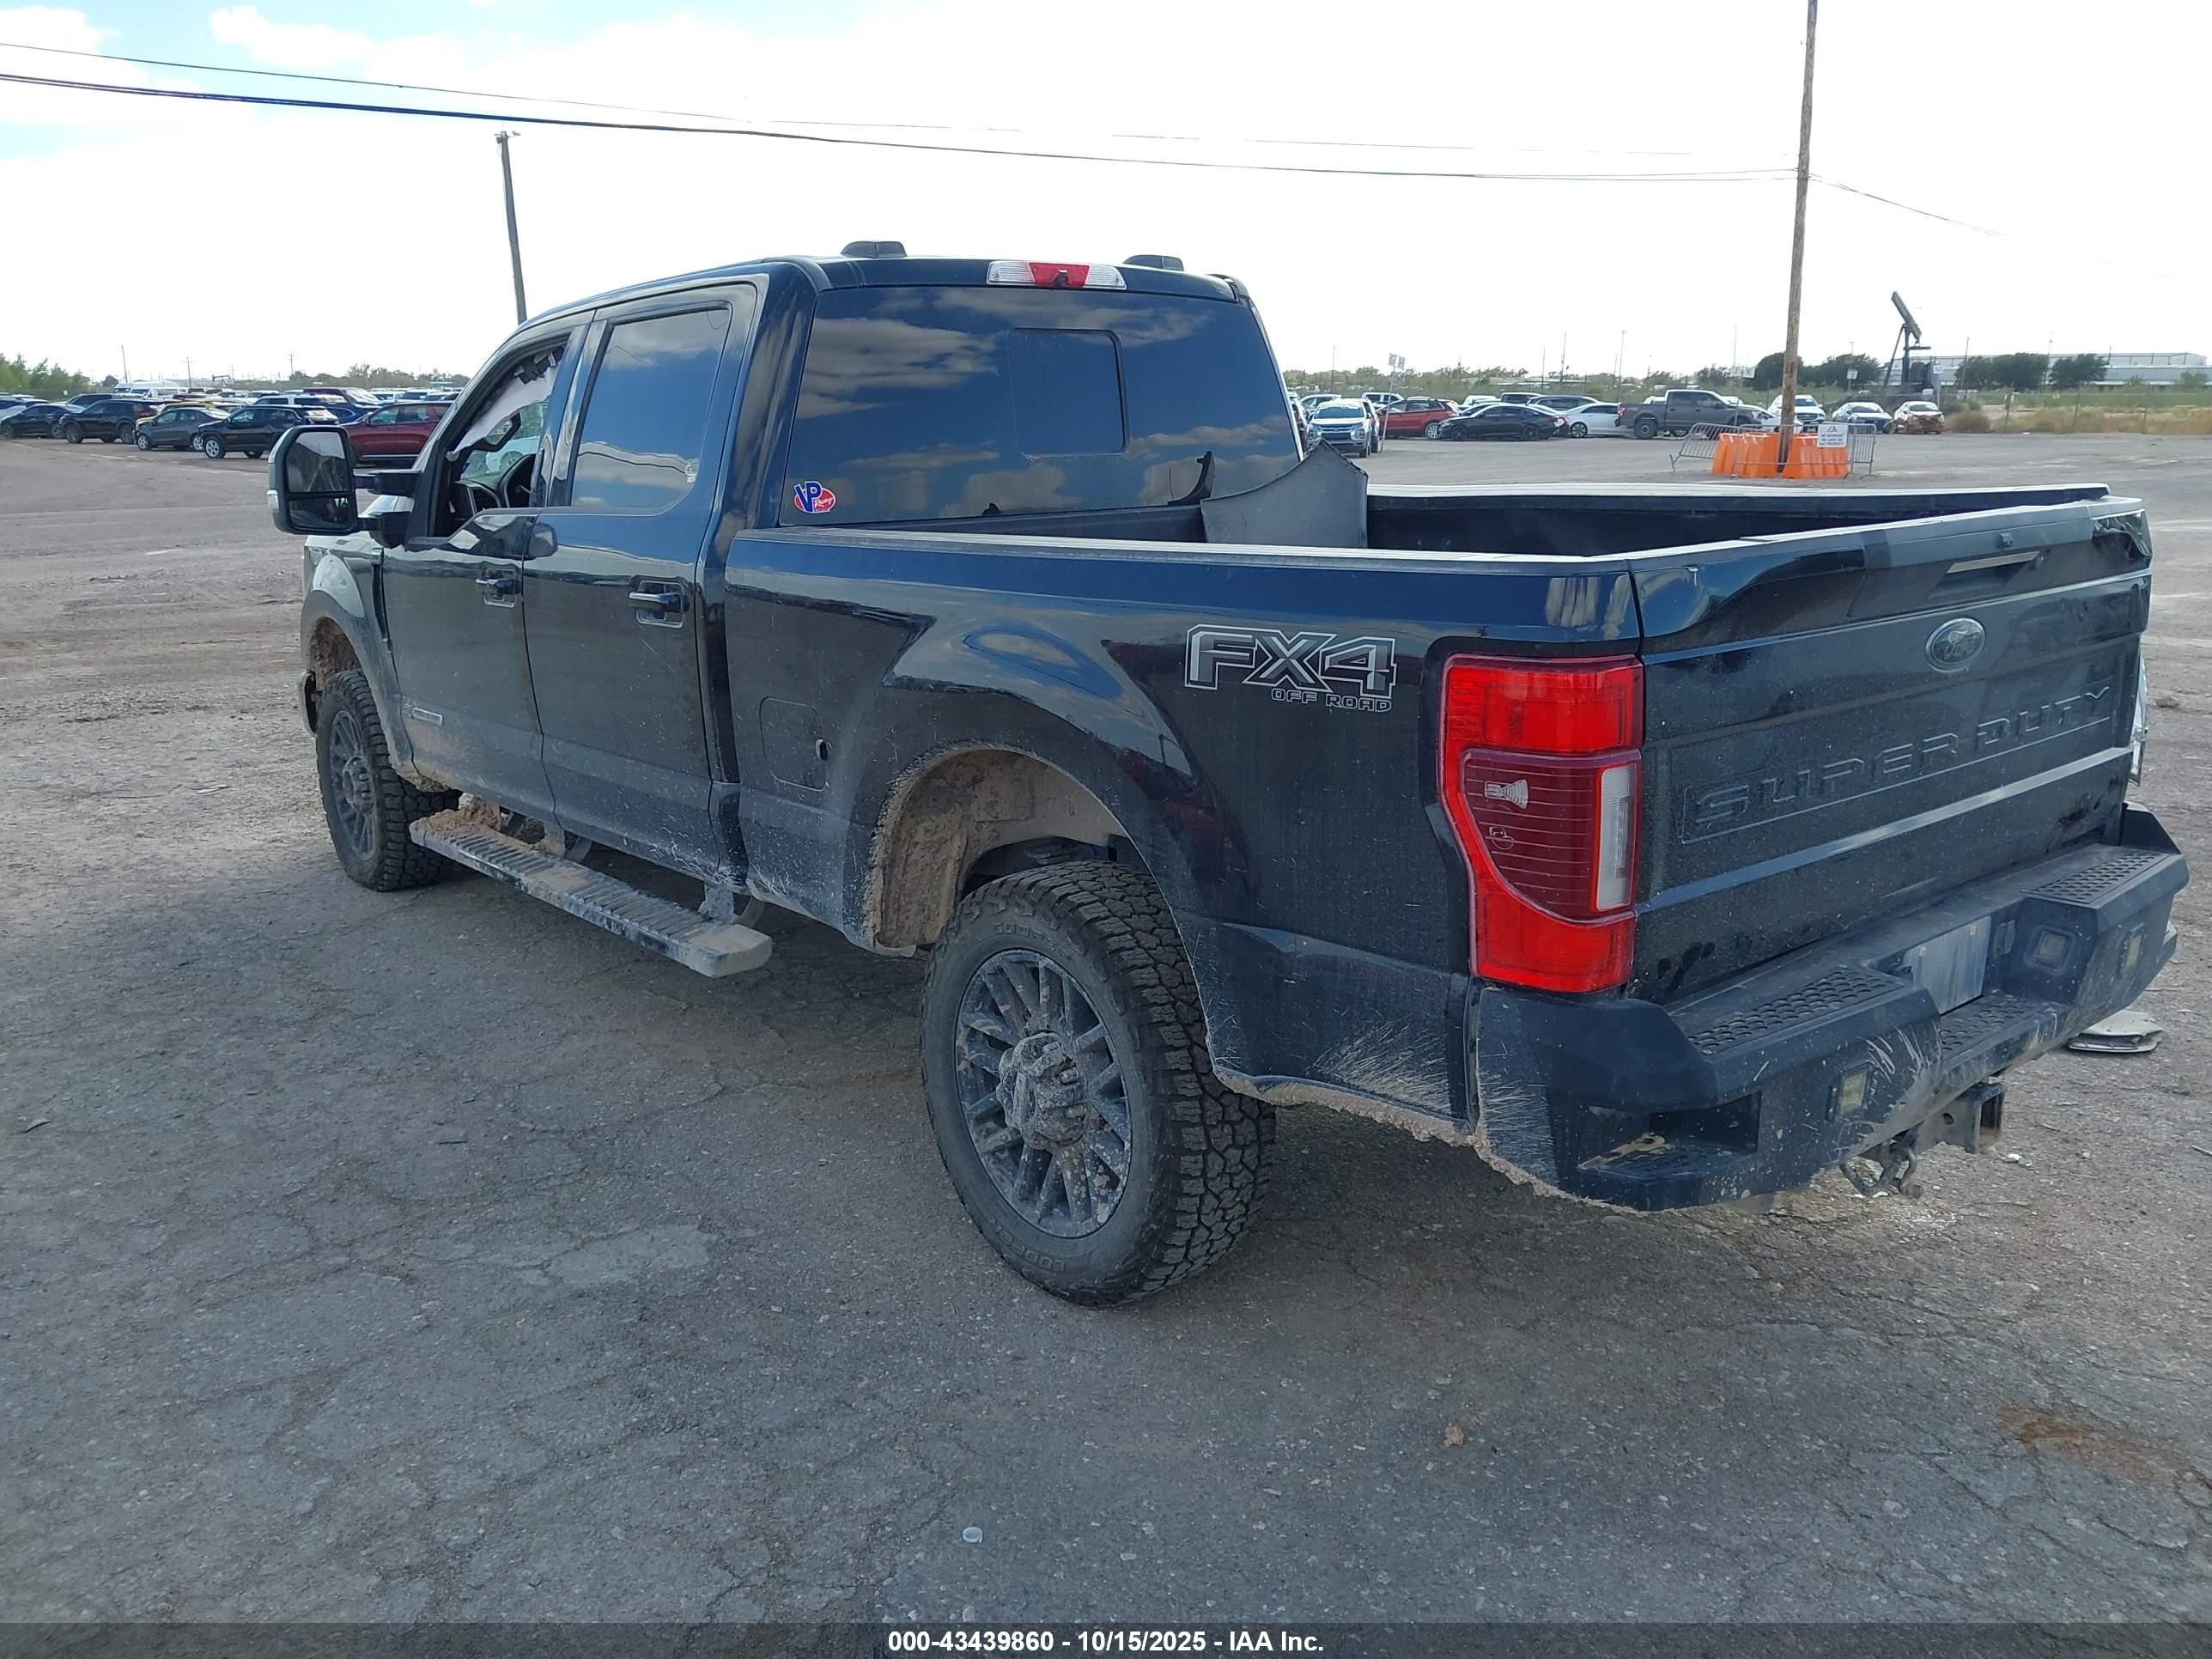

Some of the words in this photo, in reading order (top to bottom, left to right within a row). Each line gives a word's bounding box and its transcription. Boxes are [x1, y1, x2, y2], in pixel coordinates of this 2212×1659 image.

[793, 481, 822, 514] VP
[1185, 624, 1396, 699] FX4
[1272, 688, 1317, 704] OFF
[1326, 693, 1392, 713] ROAD
[1695, 732, 1959, 825] SUPER
[1975, 686, 2110, 750] DUTY
